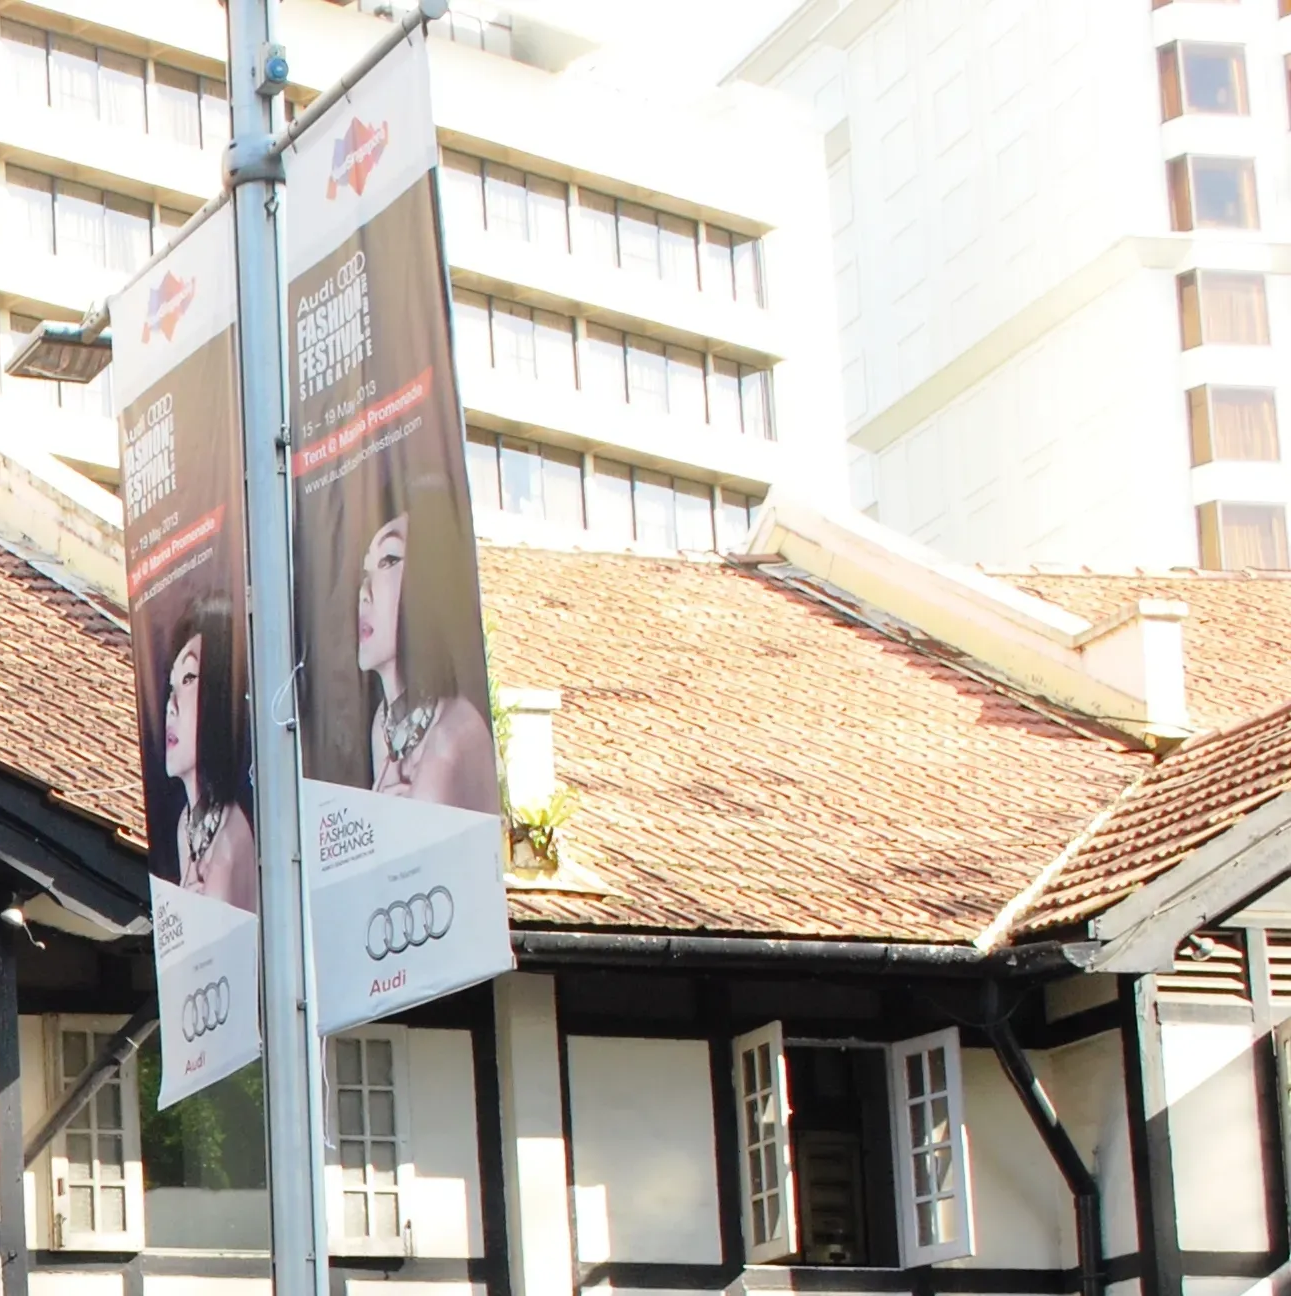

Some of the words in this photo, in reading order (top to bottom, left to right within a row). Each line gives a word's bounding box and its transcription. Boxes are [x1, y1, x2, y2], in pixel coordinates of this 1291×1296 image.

[297, 276, 335, 318] Audi
[297, 277, 363, 354] FASHION
[302, 421, 314, 439] 15
[324, 408, 336, 427] 19
[303, 444, 327, 467] Tent
[367, 384, 423, 427] Promenade
[320, 808, 347, 831] ASIA
[320, 816, 364, 846] FASHION
[320, 826, 374, 862] EXCHANGE
[369, 969, 407, 997] Audi
[184, 1050, 206, 1076] Audi
